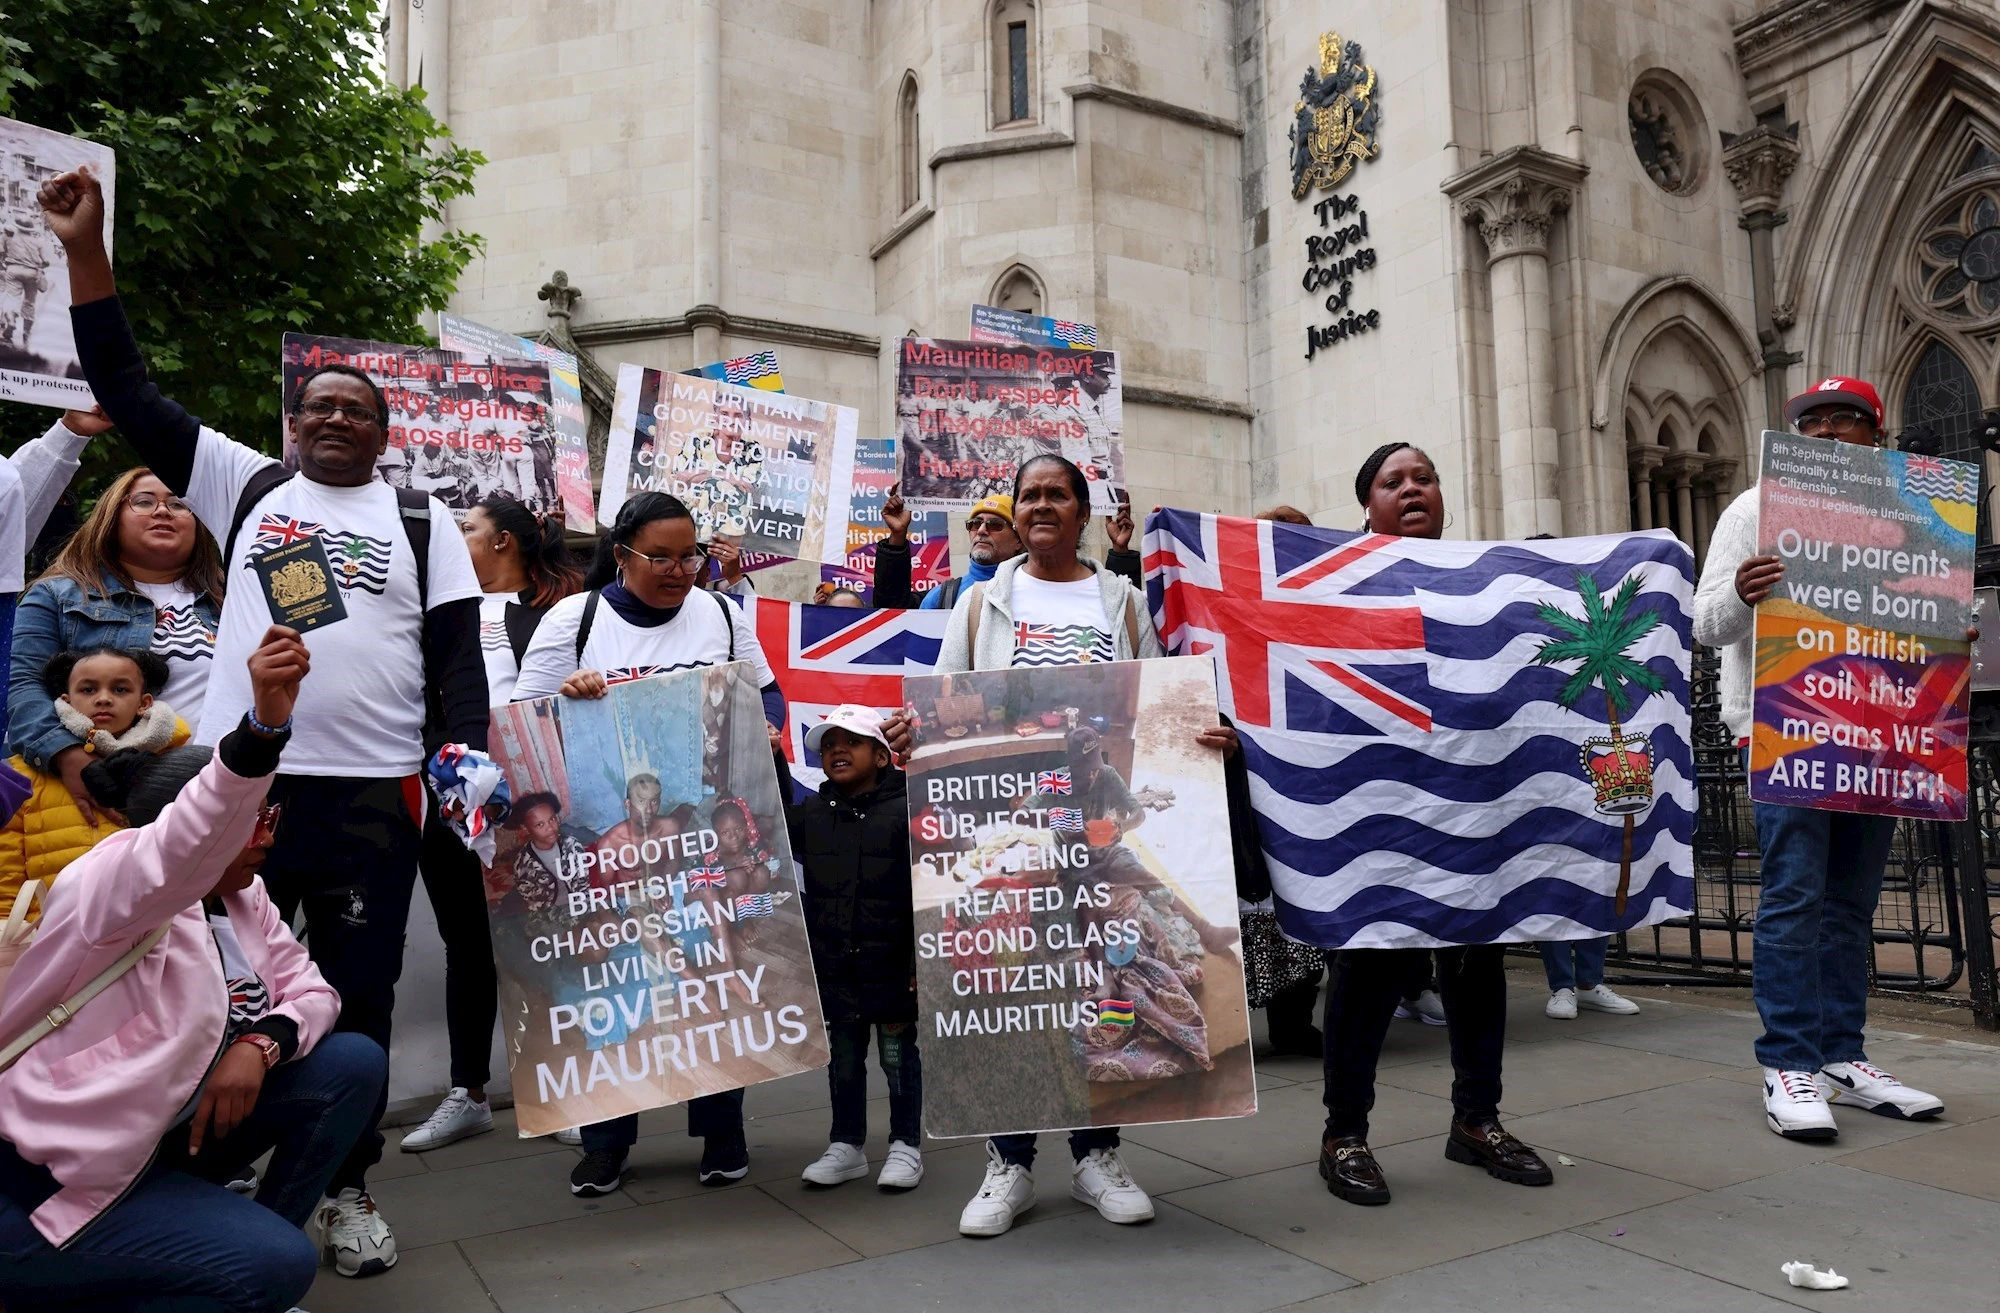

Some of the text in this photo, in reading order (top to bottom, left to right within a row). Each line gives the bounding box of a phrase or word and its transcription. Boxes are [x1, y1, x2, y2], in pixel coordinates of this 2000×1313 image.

[1314, 193, 1359, 228] The
[1305, 211, 1368, 263] Royal
[1302, 247, 1377, 294] Courts
[1326, 280, 1352, 313] of
[447, 326, 487, 345] Nationality
[494, 342, 520, 356] Borders
[453, 335, 493, 354] Citizenship
[976, 317, 1010, 330] Nationality
[1017, 325, 1040, 335] Borders
[981, 326, 1015, 339] Citizenship
[1305, 308, 1380, 361] Justice
[292, 343, 542, 392] Mauritian Police
[906, 342, 1094, 376] Mauritian Govt
[1, 385, 15, 396] is.
[13, 376, 28, 386] up
[32, 378, 91, 393] protesters
[672, 383, 803, 421] MAURITIAN
[914, 376, 1080, 408] Don't respect
[437, 397, 546, 425] against
[653, 404, 818, 447] GOVERNMENT
[919, 409, 1084, 440] Chagossians
[388, 425, 524, 454] gossians
[668, 430, 798, 468] STOLE OUR
[1772, 442, 1854, 467] 8th September,
[637, 450, 829, 497] COMPENSATION
[919, 452, 1016, 479] Human
[1771, 459, 1900, 489] Nationality & Borders Bill
[632, 472, 825, 521] MADE US LIVE IN
[852, 482, 878, 498] We
[908, 498, 945, 506] Chagossian
[1779, 477, 1838, 497] Citizenship
[1769, 491, 1933, 525] Historical Legislative Unfairness
[715, 511, 824, 543] POVERTY
[1777, 528, 1950, 579] Our parents
[832, 577, 866, 593] The
[1787, 581, 1862, 612] were
[1872, 585, 1938, 622] born
[1797, 626, 1926, 665] on British
[1803, 670, 1917, 709] soil, this
[1782, 716, 1935, 756] means WE
[927, 771, 1036, 803] BRITISH
[1767, 756, 1945, 803] ARE BRITISH!
[555, 827, 720, 882] UPROOTED
[919, 850, 997, 878] STIL
[567, 870, 690, 917] BRITISH
[938, 882, 1111, 919] TREATED AS
[530, 898, 736, 963] CHAGOSSIAN
[918, 918, 1140, 960] SECOND CLASS
[582, 938, 727, 992] LIVING IN
[952, 960, 1105, 997] CITIZEN IN
[549, 964, 768, 1045] POVERTY
[935, 1000, 1098, 1038] MAURITIUS
[535, 1004, 808, 1104] MAURITIUS
